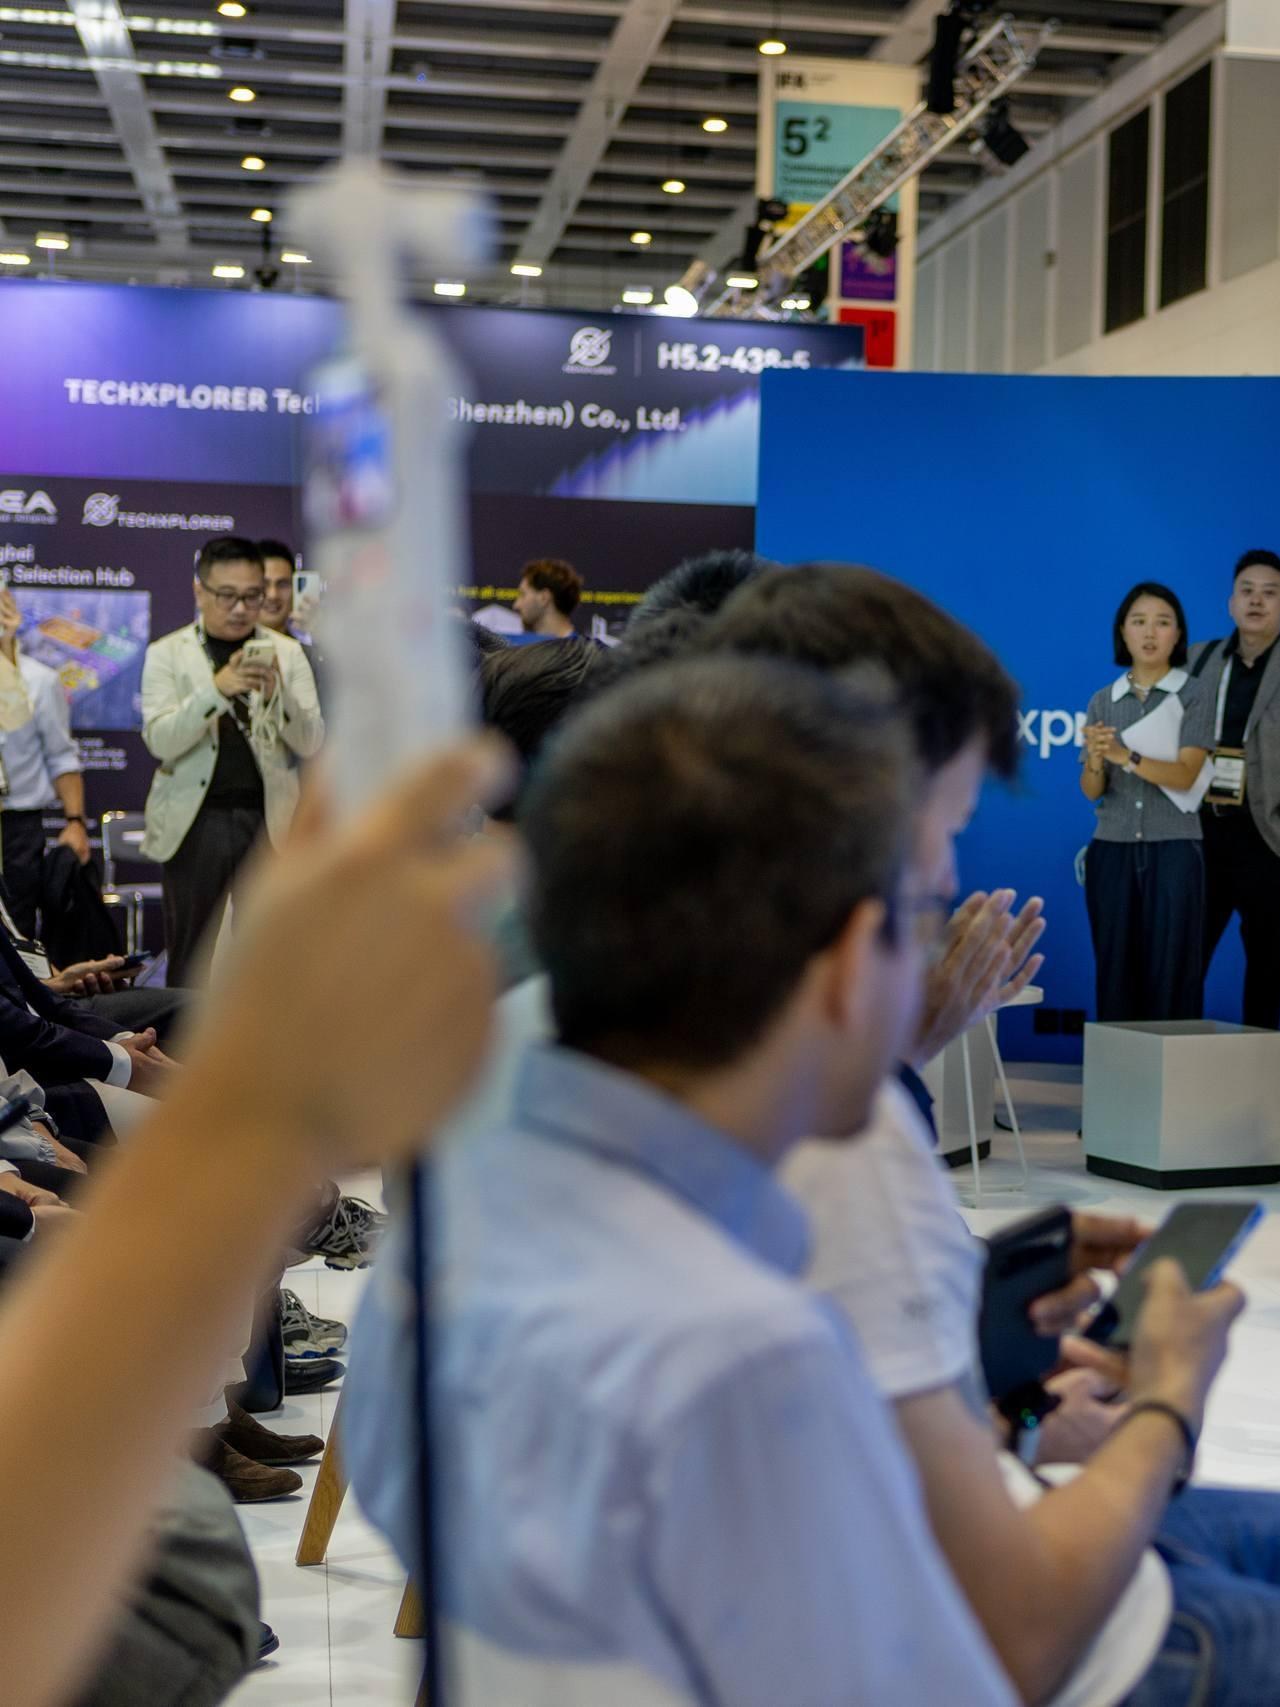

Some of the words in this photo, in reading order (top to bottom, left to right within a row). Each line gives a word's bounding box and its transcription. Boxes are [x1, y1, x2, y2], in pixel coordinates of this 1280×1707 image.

[64, 378, 268, 412] TECHXPLORER
[580, 404, 630, 433] Co.,
[636, 406, 688, 431] Ltd.
[12, 563, 94, 586] Selection
[95, 566, 135, 587] Hub
